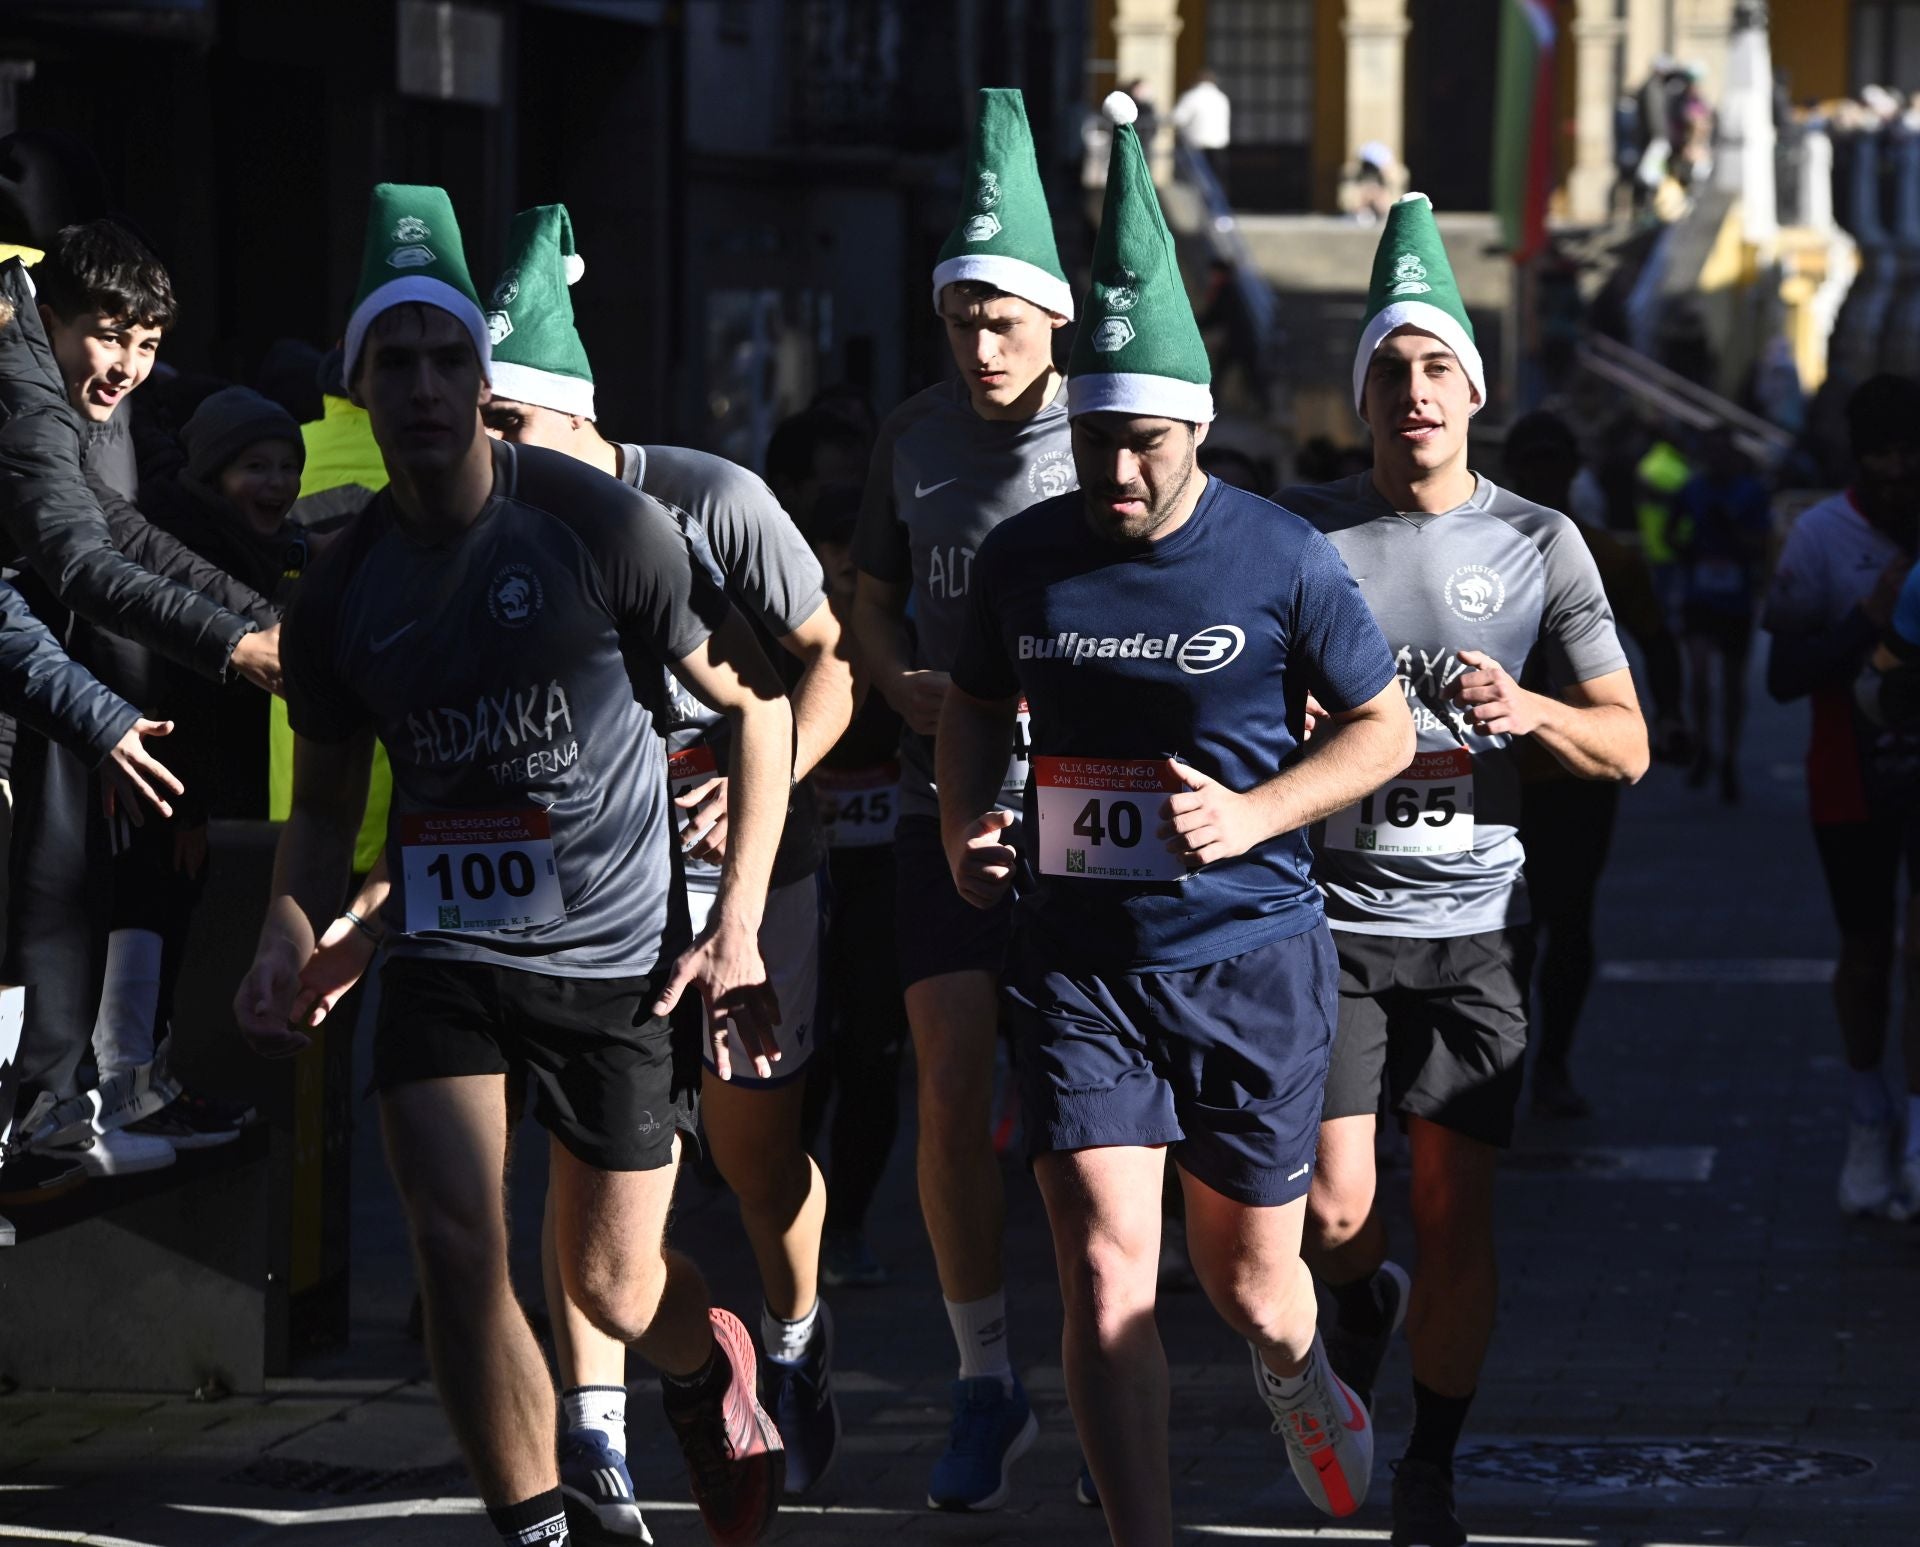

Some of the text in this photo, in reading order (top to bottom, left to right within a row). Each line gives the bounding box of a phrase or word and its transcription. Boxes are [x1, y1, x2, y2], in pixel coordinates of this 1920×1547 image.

[1018, 632, 1179, 666] Bullpadel
[406, 679, 572, 765] ALDAXKA
[488, 740, 579, 786] TABERNA
[1053, 775, 1163, 790] SAN SILBESTRE KROSA
[1073, 798, 1142, 848] 40
[427, 851, 536, 901] 100
